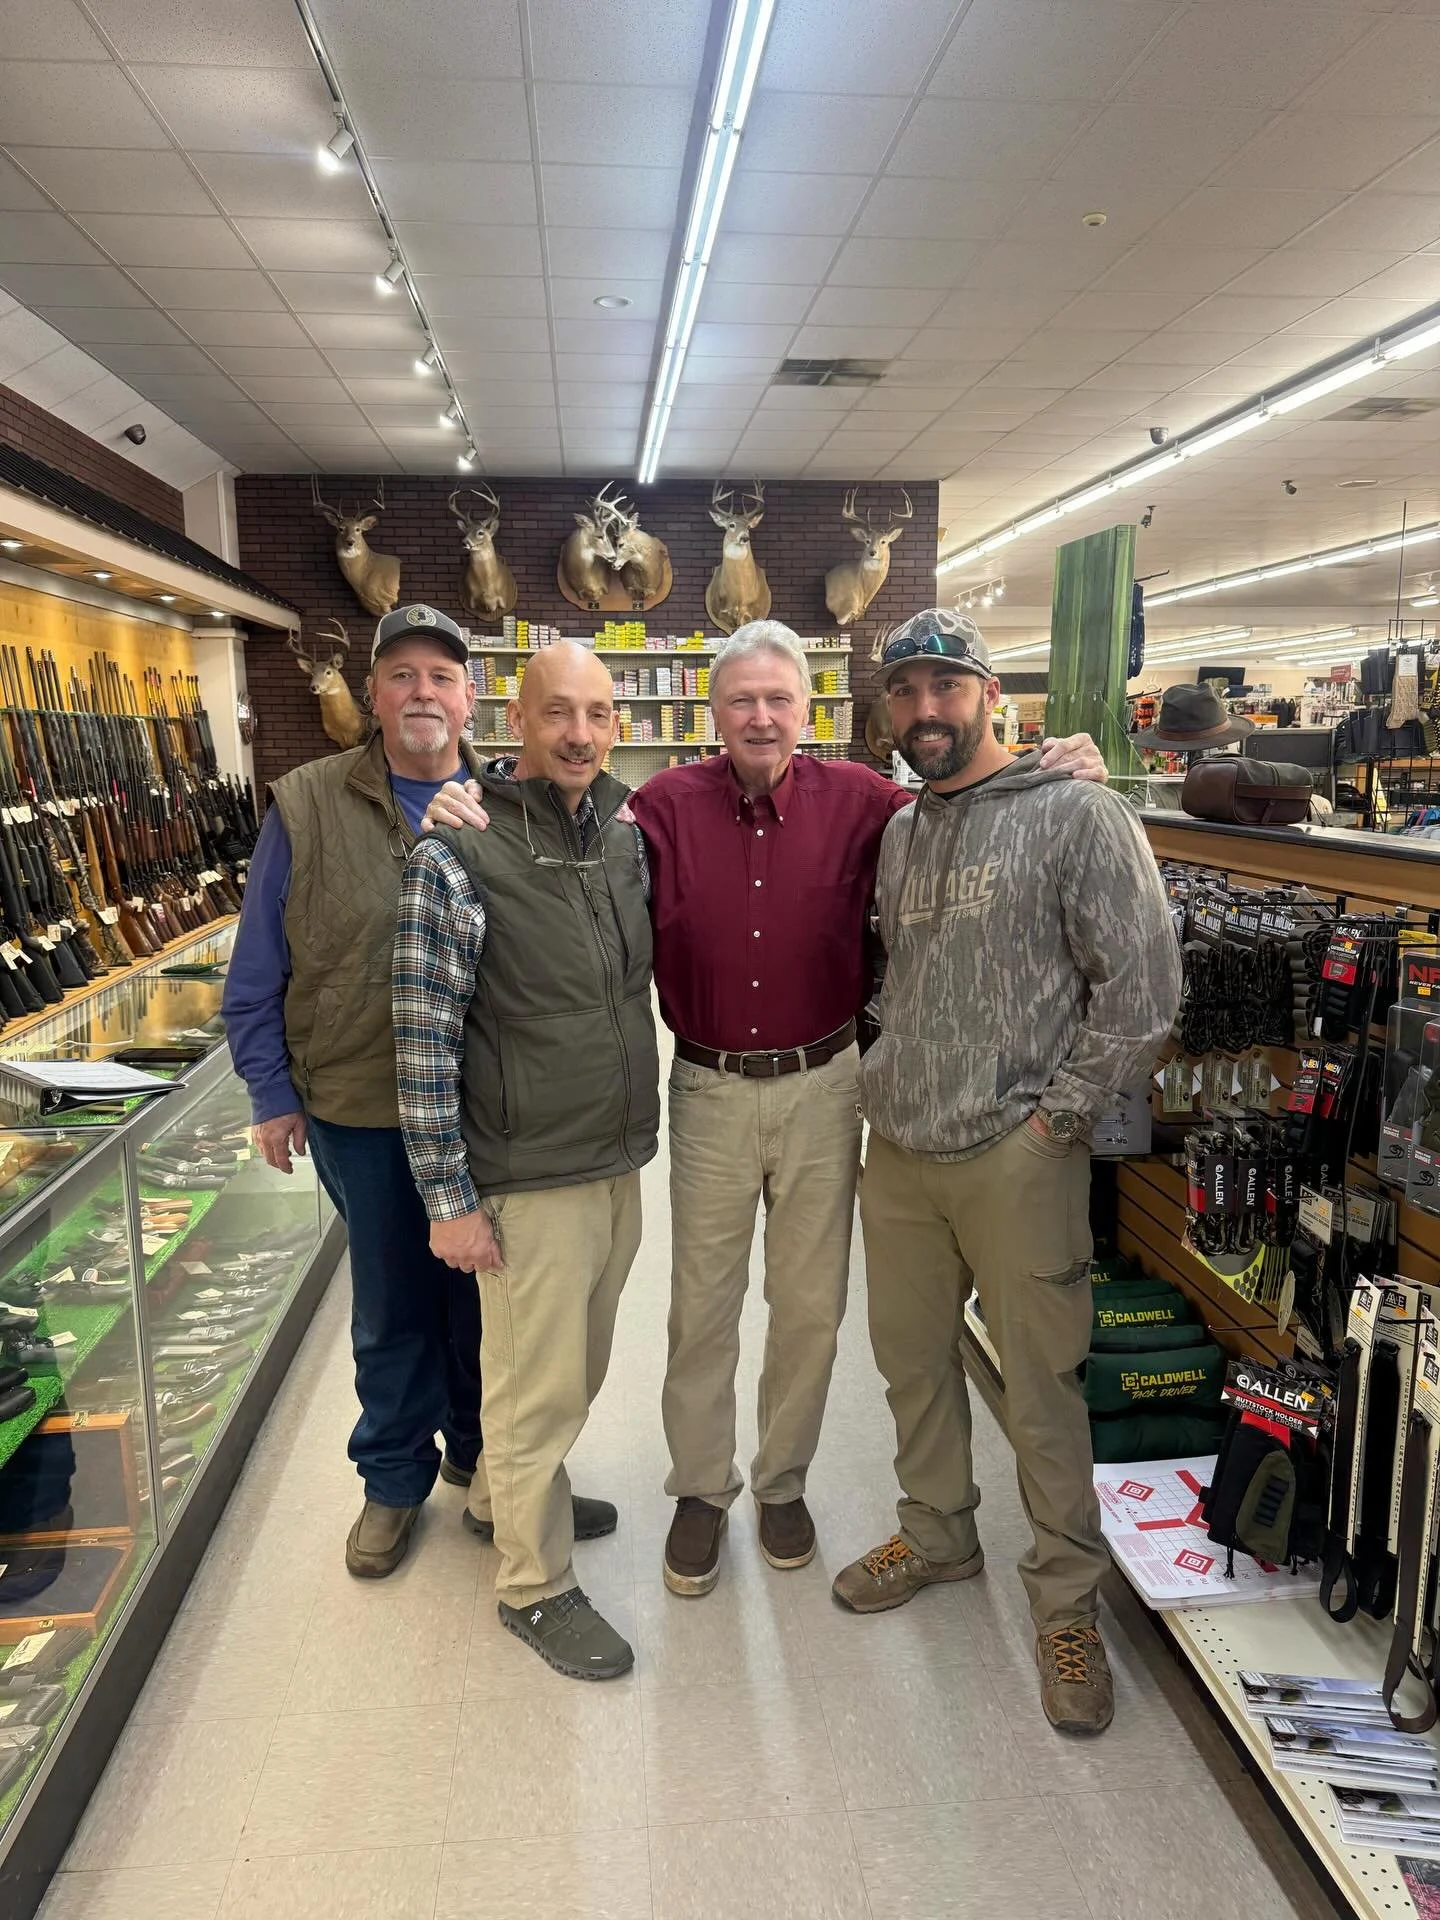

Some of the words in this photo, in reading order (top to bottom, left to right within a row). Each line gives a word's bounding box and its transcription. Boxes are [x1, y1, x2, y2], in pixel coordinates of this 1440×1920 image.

[1115, 1309, 1175, 1323] CALDWELL
[1131, 1389, 1156, 1400] TACK
[1160, 1385, 1198, 1397] DRIVER
[1141, 1369, 1207, 1386] CALDWELL
[1235, 1395, 1274, 1414] BUTTSTOCK
[1275, 1411, 1303, 1425] HOLDER
[1249, 1380, 1309, 1411] ALLEN
[1400, 1368, 1411, 1438] EXCEPTIONAL
[1233, 1401, 1264, 1416] SUPPORT
[1275, 1416, 1302, 1431] CROSSE
[1393, 1444, 1404, 1524] CRAFTSMANSHIP
